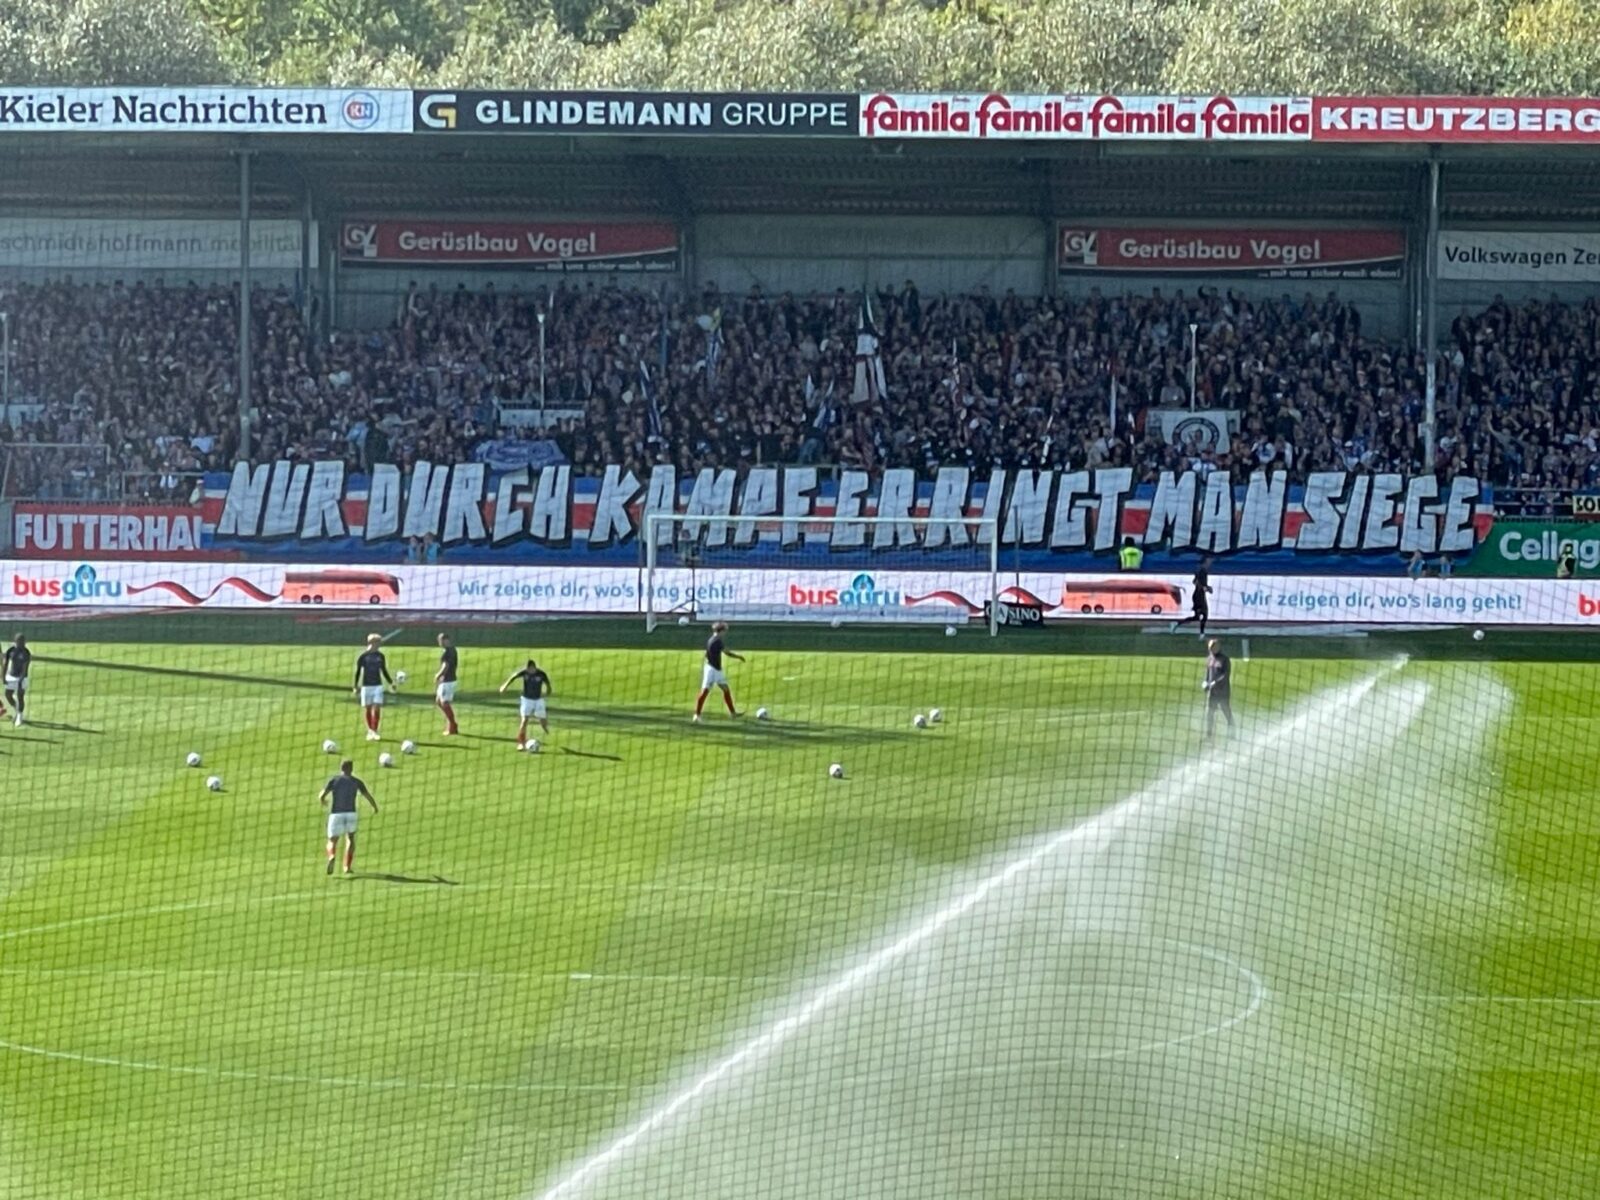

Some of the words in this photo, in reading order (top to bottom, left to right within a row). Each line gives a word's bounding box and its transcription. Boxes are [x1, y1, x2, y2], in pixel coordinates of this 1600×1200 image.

[0, 95, 103, 122] Kieler
[113, 95, 327, 125] Nachrichten
[475, 100, 711, 125] GLINDEMANN
[722, 101, 848, 127] GRUPPE
[863, 94, 970, 136] famila
[975, 94, 1083, 137] famila
[1088, 95, 1196, 138] famila
[1202, 95, 1309, 139] famila
[1321, 107, 1600, 132] KREUTZBERG
[399, 231, 518, 251] Gerüstbau
[527, 231, 596, 257] Vogel
[1119, 238, 1241, 260] Gerüstbau
[1250, 239, 1320, 264] Vogel
[1445, 246, 1567, 268] Volkswagen
[1573, 247, 1600, 265] Ze
[217, 460, 345, 539] NUR
[365, 461, 571, 542] DURCH
[1145, 470, 1287, 553] MAN
[1297, 472, 1479, 552] SIEGE
[14, 570, 122, 602] busguru
[458, 580, 488, 596] Wir
[494, 581, 555, 600] zeigen
[594, 583, 634, 598] wo's
[791, 580, 900, 608] busguru
[1241, 590, 1272, 606] Wir
[1278, 590, 1340, 611] zeigen
[1379, 593, 1421, 609] wo's
[1426, 592, 1465, 612] lang
[1472, 594, 1521, 613] geht!
